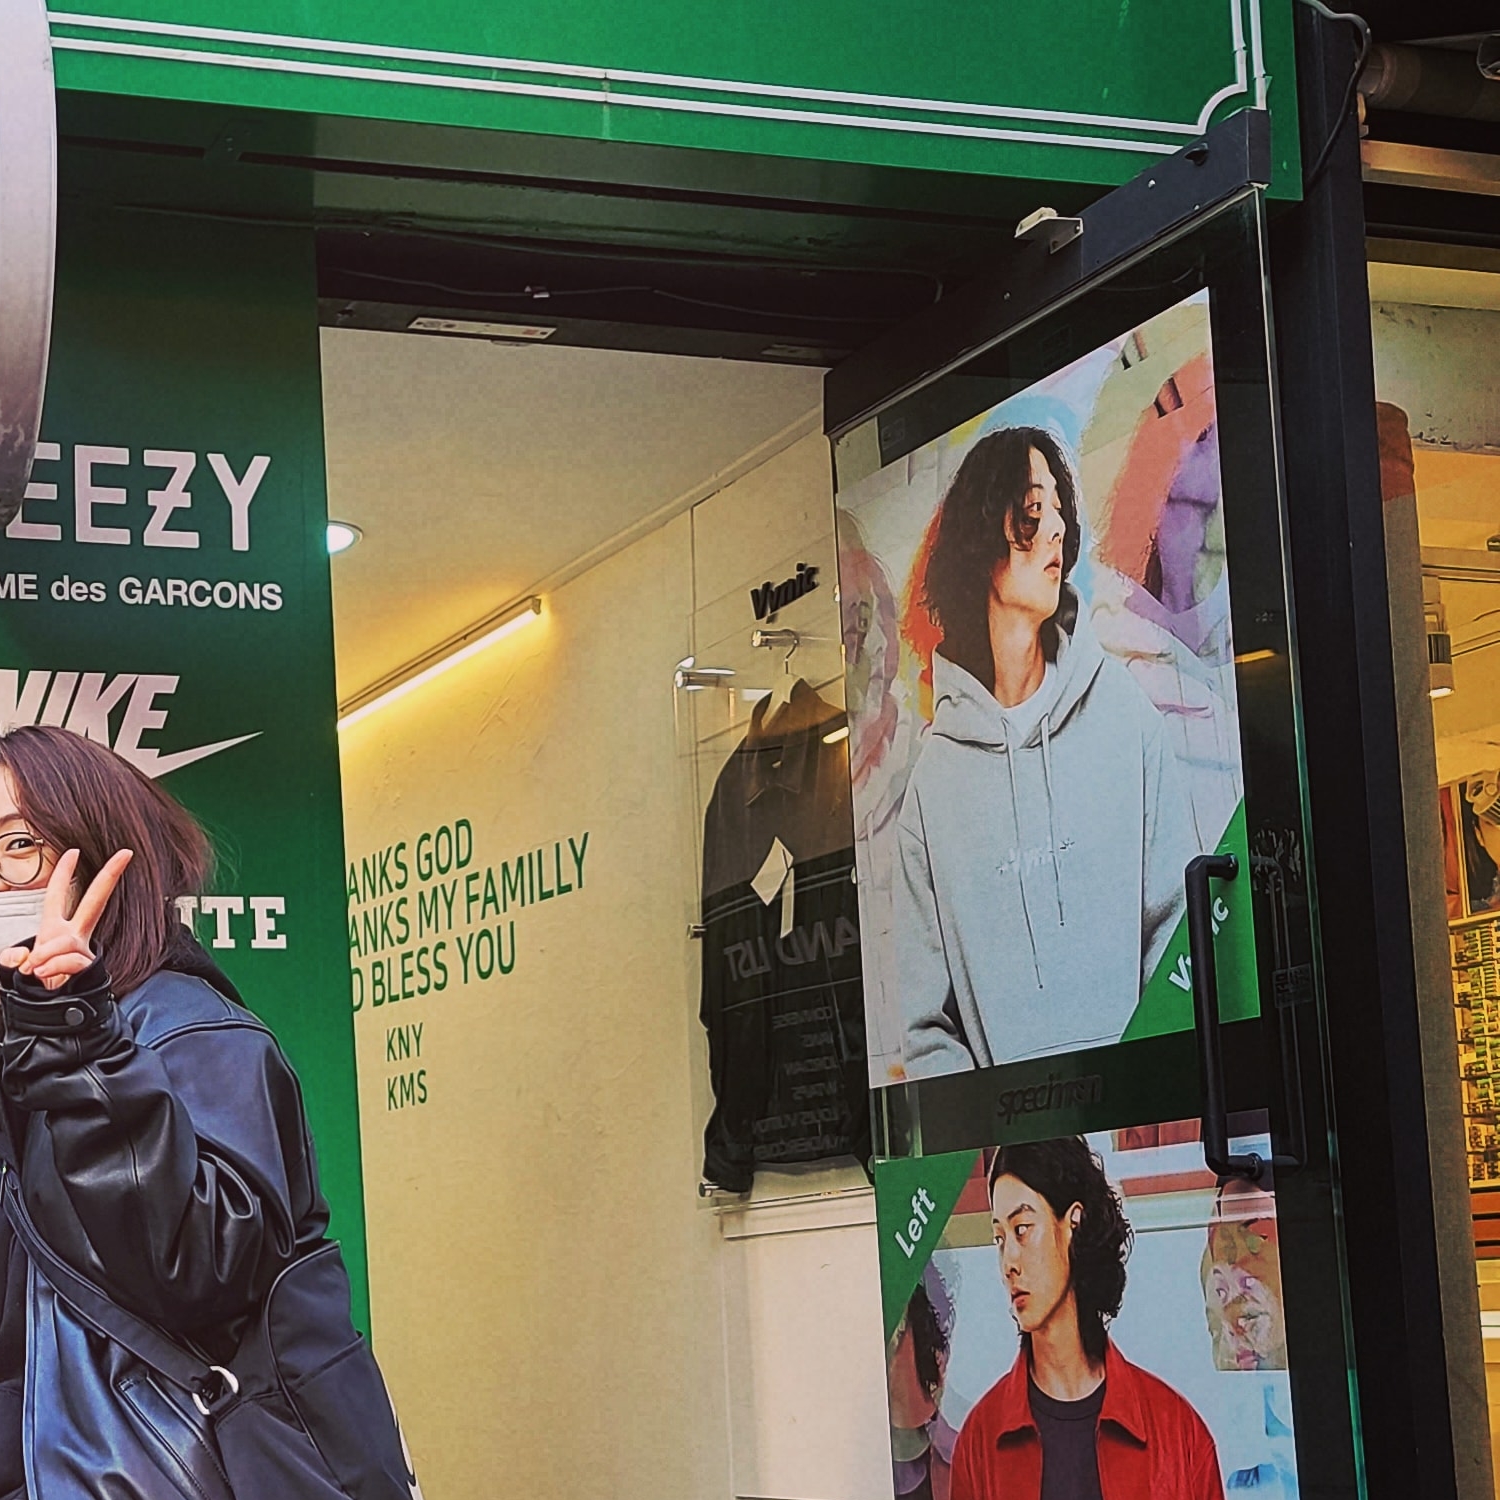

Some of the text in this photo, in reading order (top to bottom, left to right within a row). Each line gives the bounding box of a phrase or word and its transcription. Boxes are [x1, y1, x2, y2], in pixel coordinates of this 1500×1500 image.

[51, 575, 107, 603] des
[119, 577, 283, 611] GARCONS
[416, 818, 473, 882] GOD
[418, 879, 458, 939] MY
[465, 832, 590, 924] FAMILLY
[372, 941, 448, 1008] BLESS
[456, 921, 516, 984] YOU
[386, 1022, 423, 1062] KNY
[387, 1069, 428, 1111] KMS
[894, 1186, 937, 1261] Left
